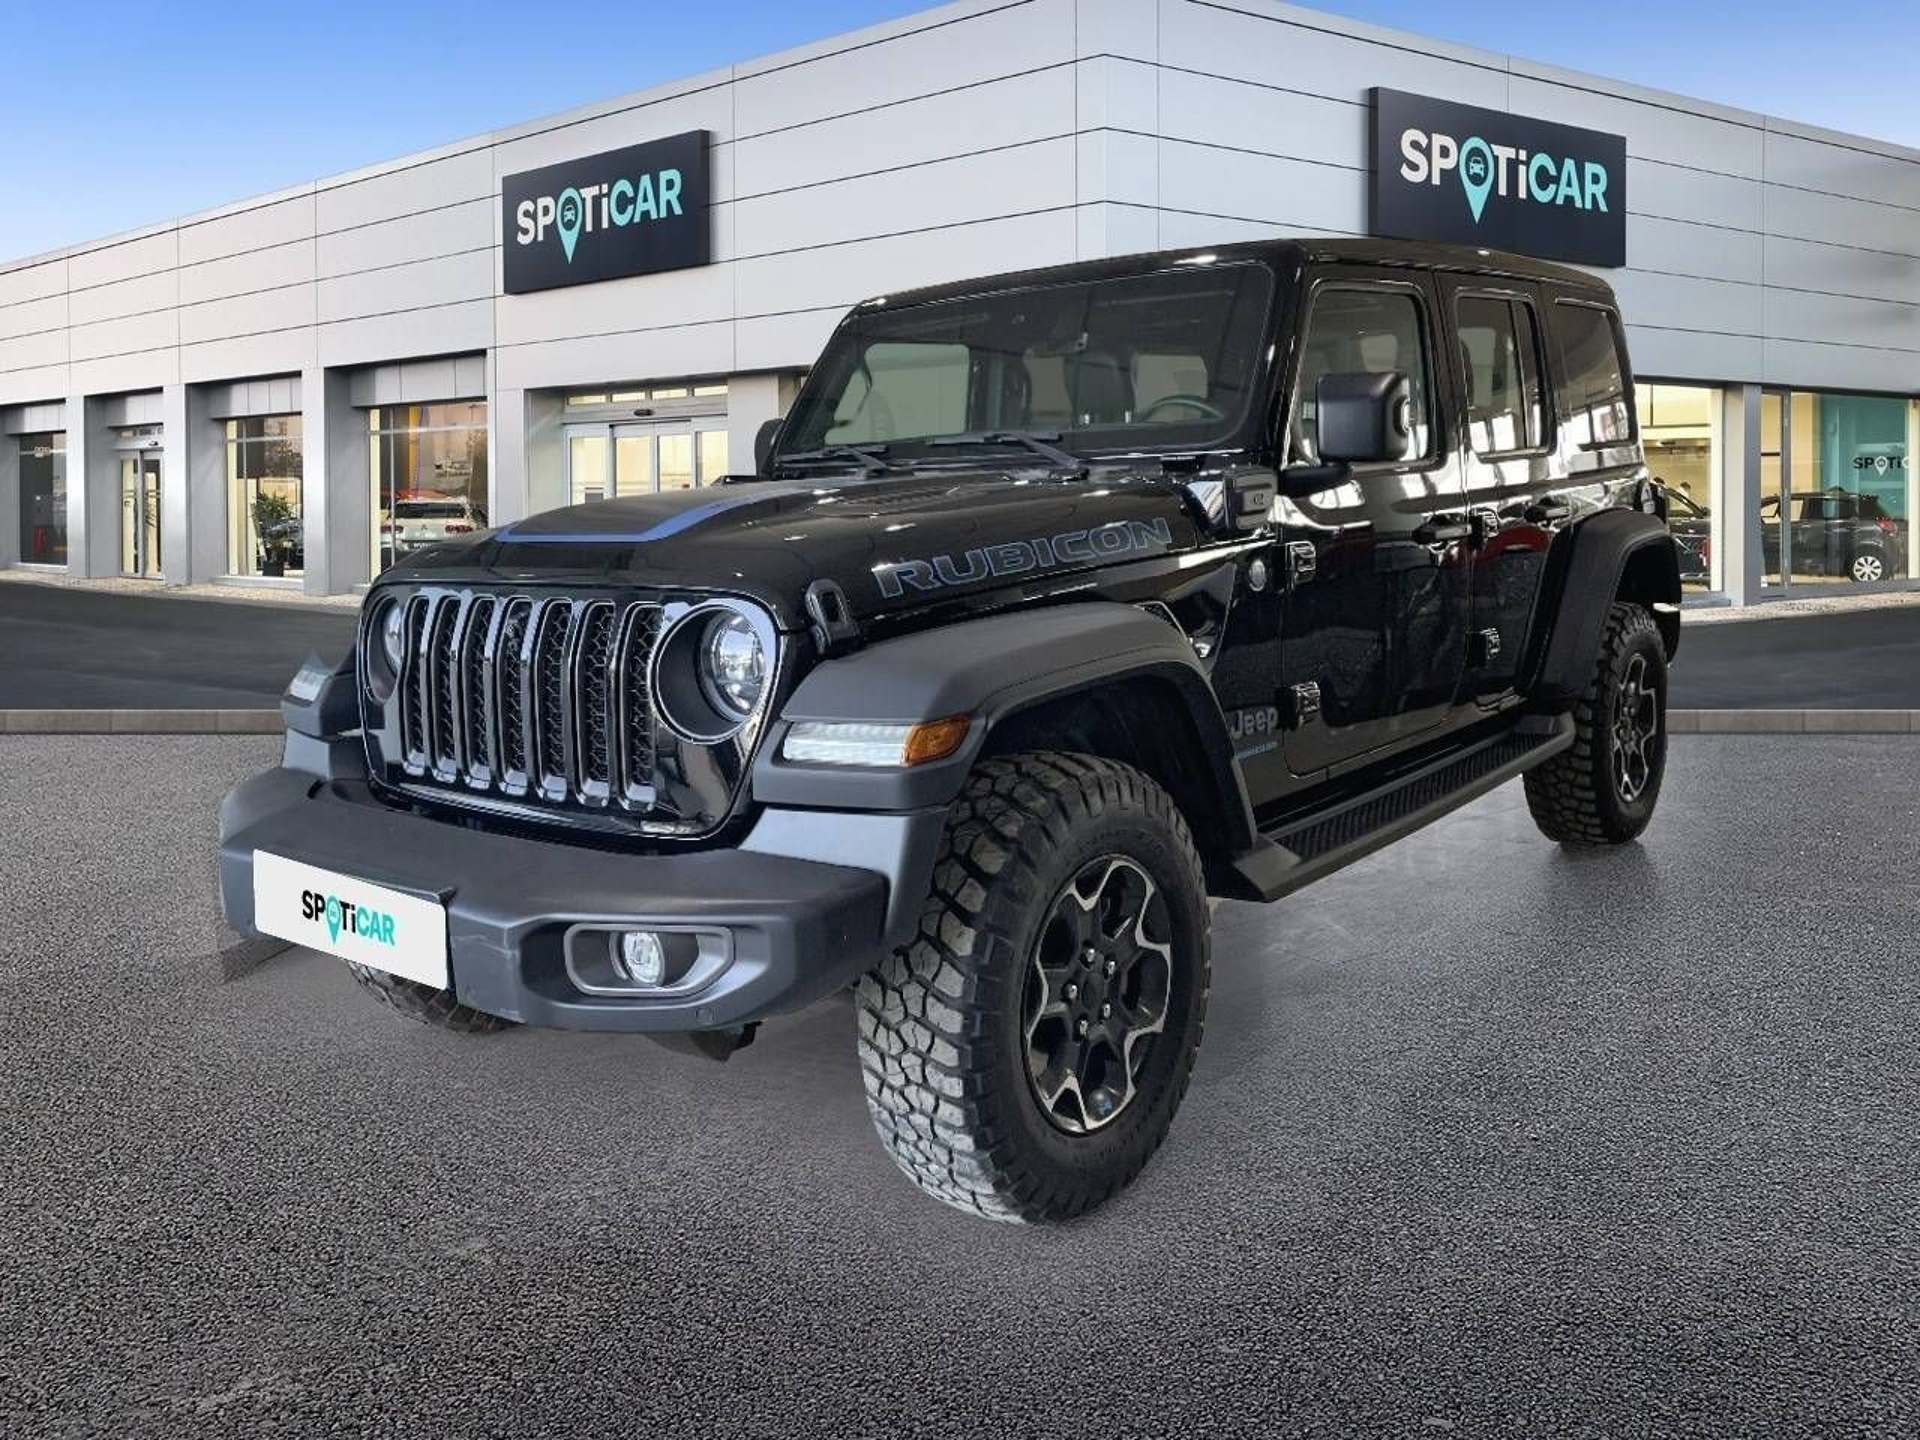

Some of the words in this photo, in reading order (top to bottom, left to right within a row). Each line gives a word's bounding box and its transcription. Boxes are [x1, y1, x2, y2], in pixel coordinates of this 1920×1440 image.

[517, 169, 682, 264] SPOTiCAR
[1400, 128, 1608, 225] SPOTiCAR
[871, 517, 1172, 599] RUBICON
[1230, 707, 1278, 740] Jeep
[302, 890, 395, 945] SPOTiCAR
